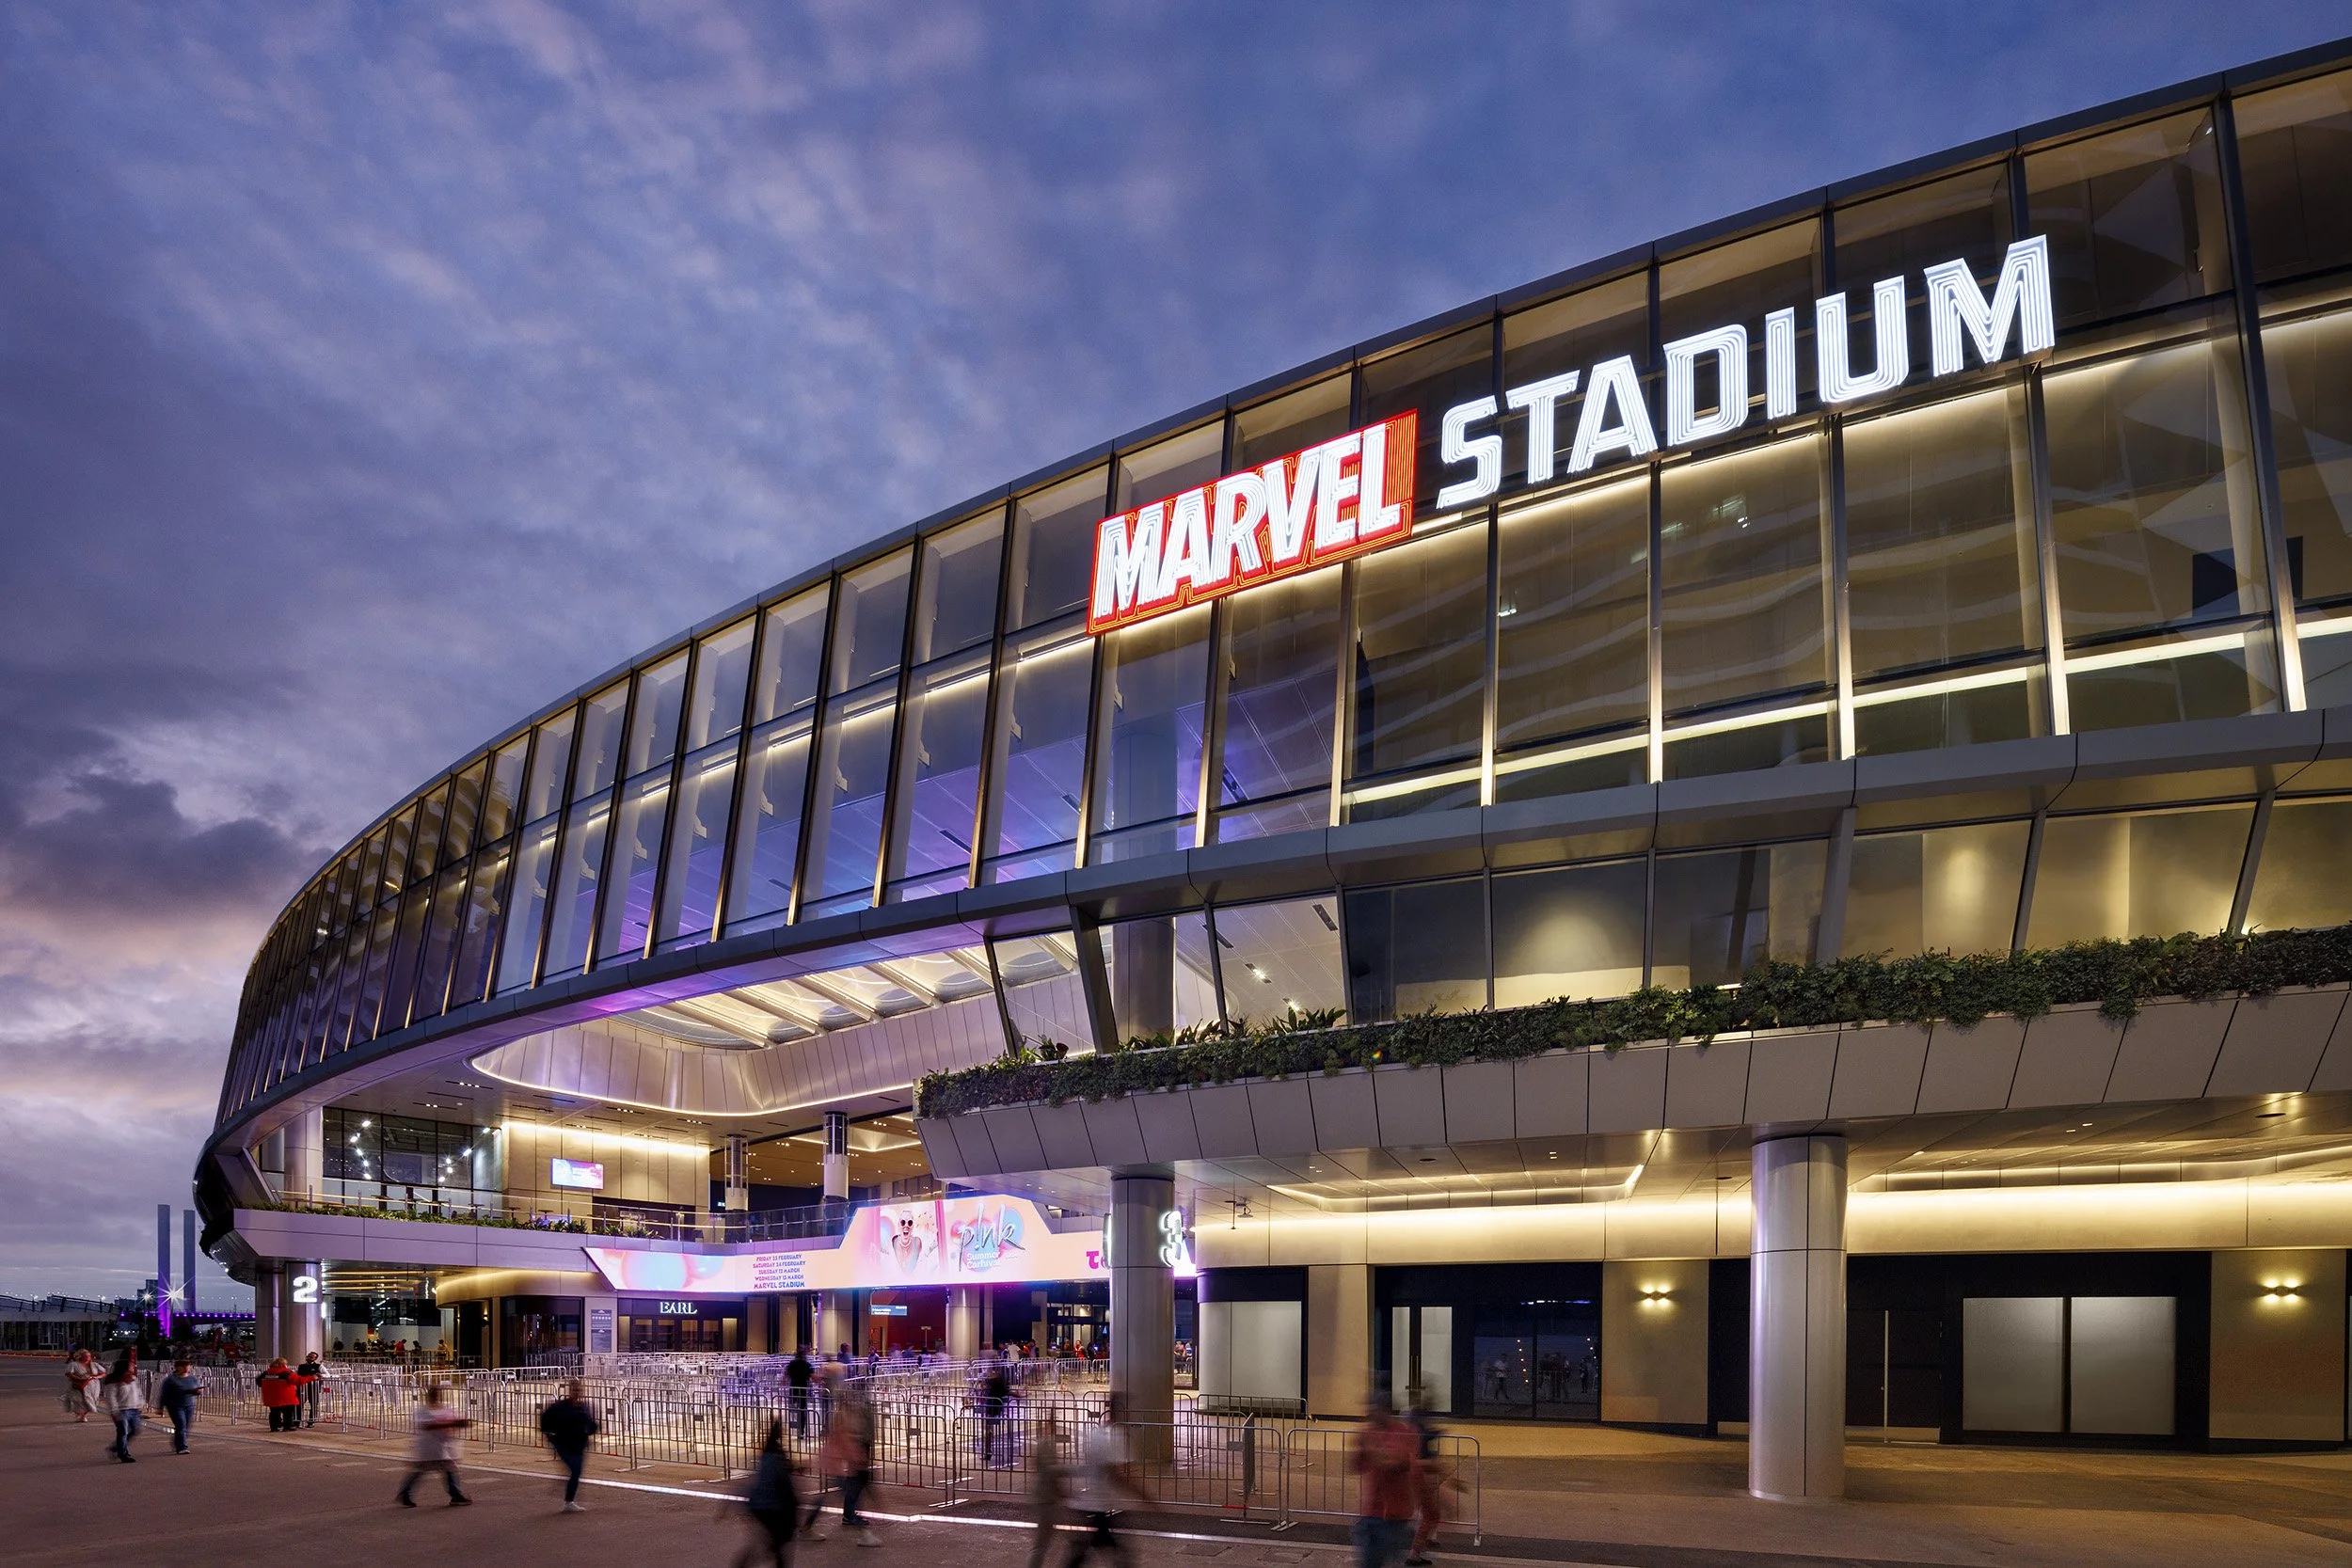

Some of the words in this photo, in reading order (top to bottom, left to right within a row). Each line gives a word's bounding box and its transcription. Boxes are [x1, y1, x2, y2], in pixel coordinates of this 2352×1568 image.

[1094, 423, 1401, 619] MARVEL
[1437, 235, 2056, 509] STADIUM
[294, 1275, 318, 1303] 2
[660, 1301, 698, 1314] EARL
